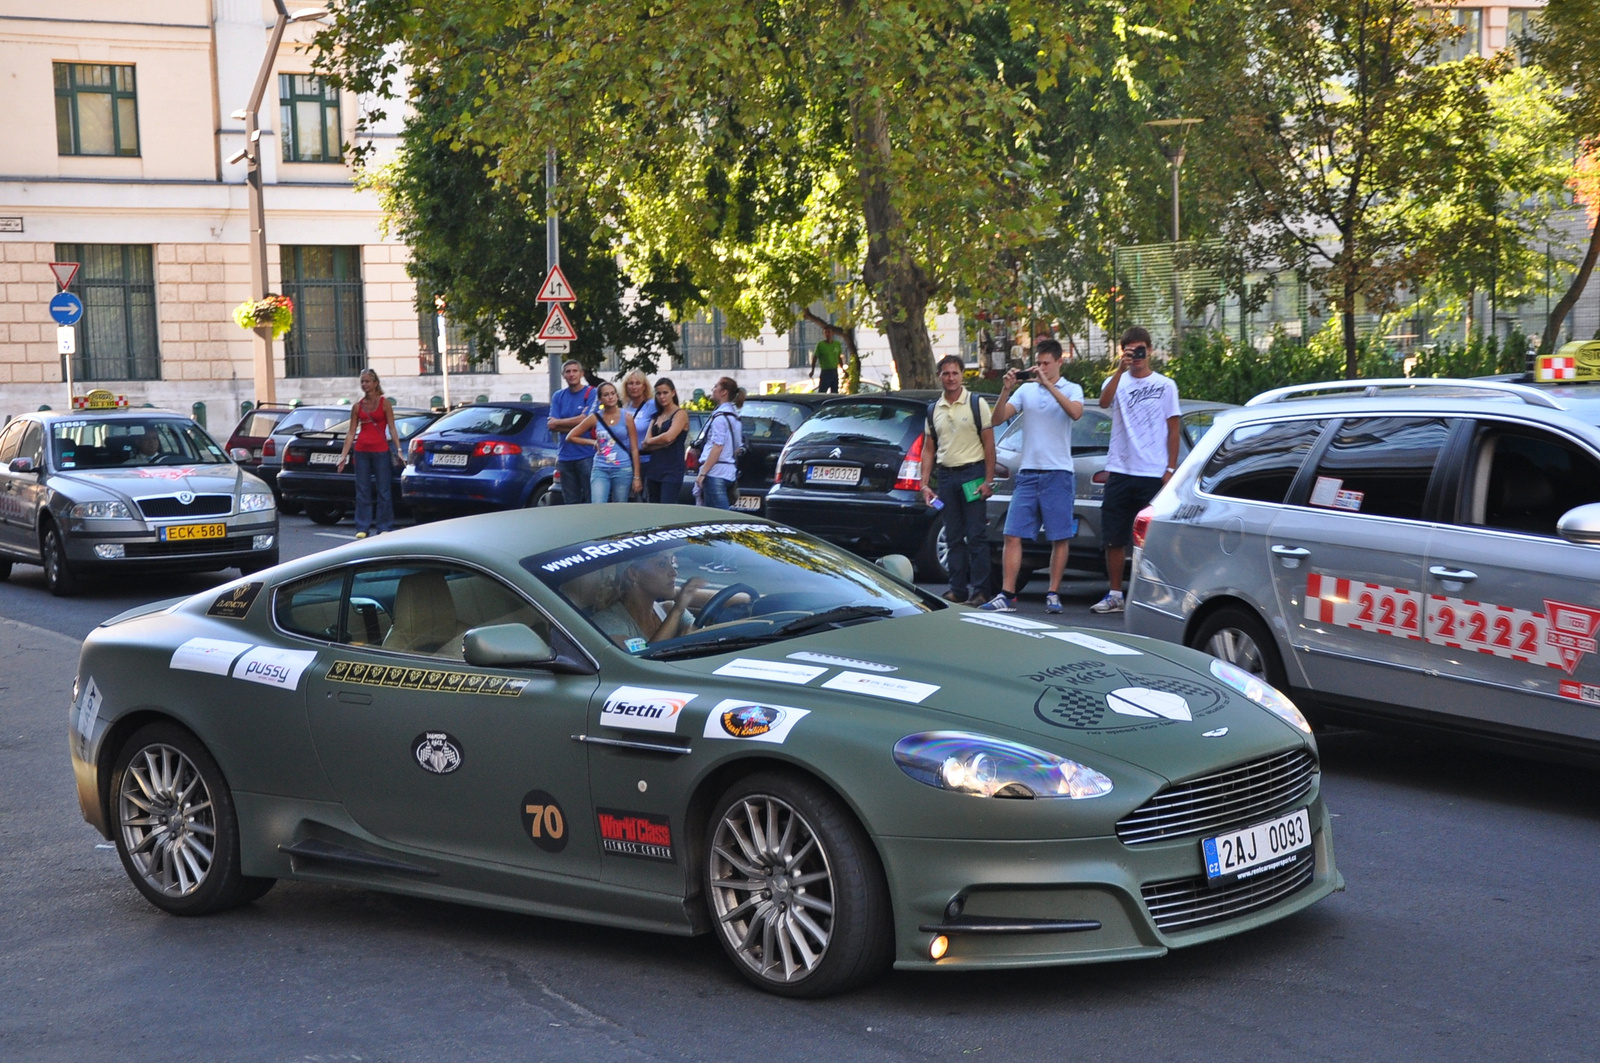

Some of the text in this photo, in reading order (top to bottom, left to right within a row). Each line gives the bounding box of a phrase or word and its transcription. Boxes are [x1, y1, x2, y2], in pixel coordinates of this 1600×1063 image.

[168, 524, 224, 539] ECK-588
[245, 661, 291, 683] pussy
[1029, 660, 1106, 683] DIAMOND
[1065, 669, 1117, 686] RACE
[525, 804, 564, 839] 70
[597, 813, 671, 847] World Class
[603, 840, 672, 858] FITNESS CENTER
[1222, 816, 1305, 869] 2AJ 0093
[1208, 862, 1219, 874] CZ
